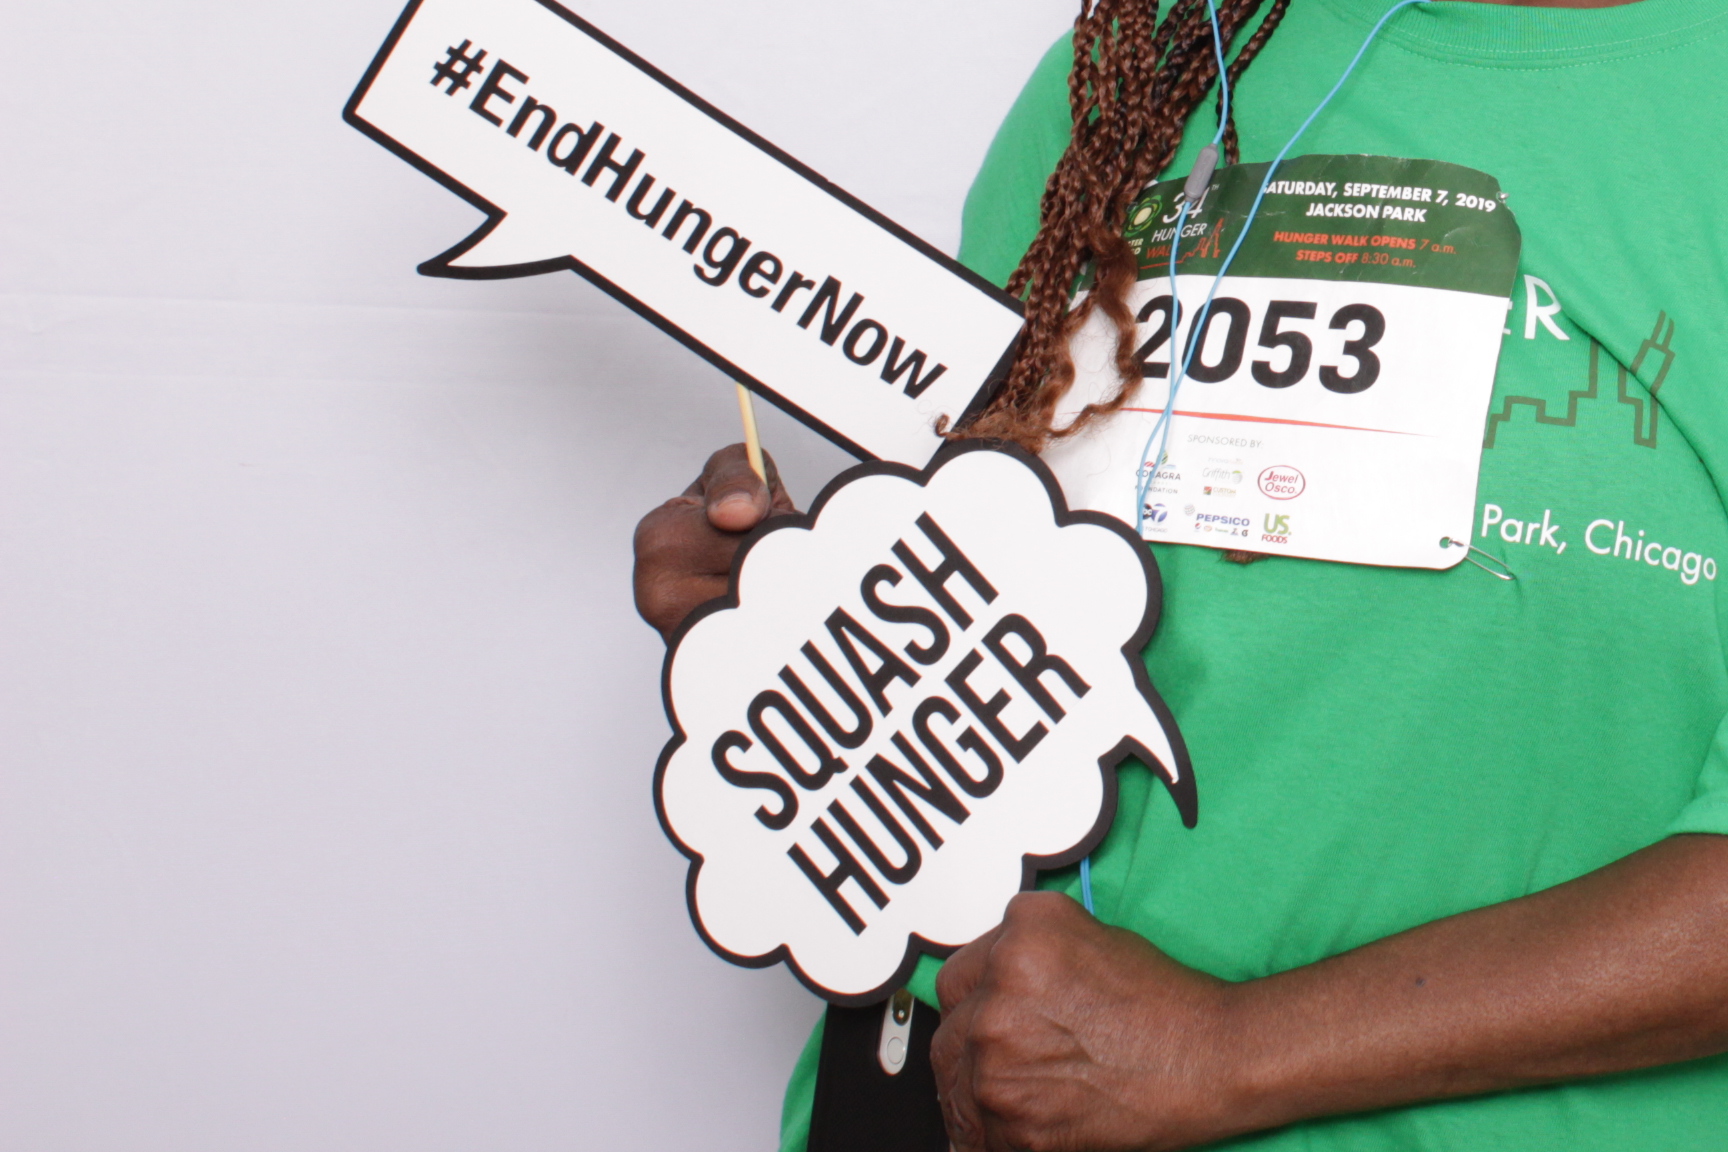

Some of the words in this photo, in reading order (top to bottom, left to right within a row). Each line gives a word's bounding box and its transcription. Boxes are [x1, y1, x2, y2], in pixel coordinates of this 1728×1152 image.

[1343, 183, 1432, 202] SEPTEMBER
[1435, 190, 1449, 206] 7,
[1455, 193, 1497, 213] 2019
[430, 38, 949, 401] #EndHungerNow
[1306, 203, 1380, 219] JACKSON
[1382, 206, 1428, 223] PARK
[1146, 242, 1181, 259] WAL
[1273, 231, 1329, 245] HUNGER
[1331, 235, 1369, 247] WALK
[1371, 236, 1416, 250] OPENS
[1419, 239, 1430, 250] 7
[1431, 242, 1457, 254] a.m.
[1296, 249, 1333, 263] STEPS
[1334, 252, 1359, 264] OFF
[1361, 253, 1389, 265] 8:30
[1391, 257, 1416, 268] a.m.
[1132, 294, 1387, 394] 2053
[1187, 434, 1248, 448] SPONSORED
[1249, 438, 1264, 449] BY:
[1264, 471, 1299, 484] Jewel
[1196, 513, 1250, 527] PEPSICO
[1261, 534, 1288, 544] FOODS
[1480, 504, 1568, 555] Park,
[1584, 519, 1718, 585] Chicago
[710, 510, 1000, 831] SQUASH
[786, 612, 1092, 936] HUNGER
